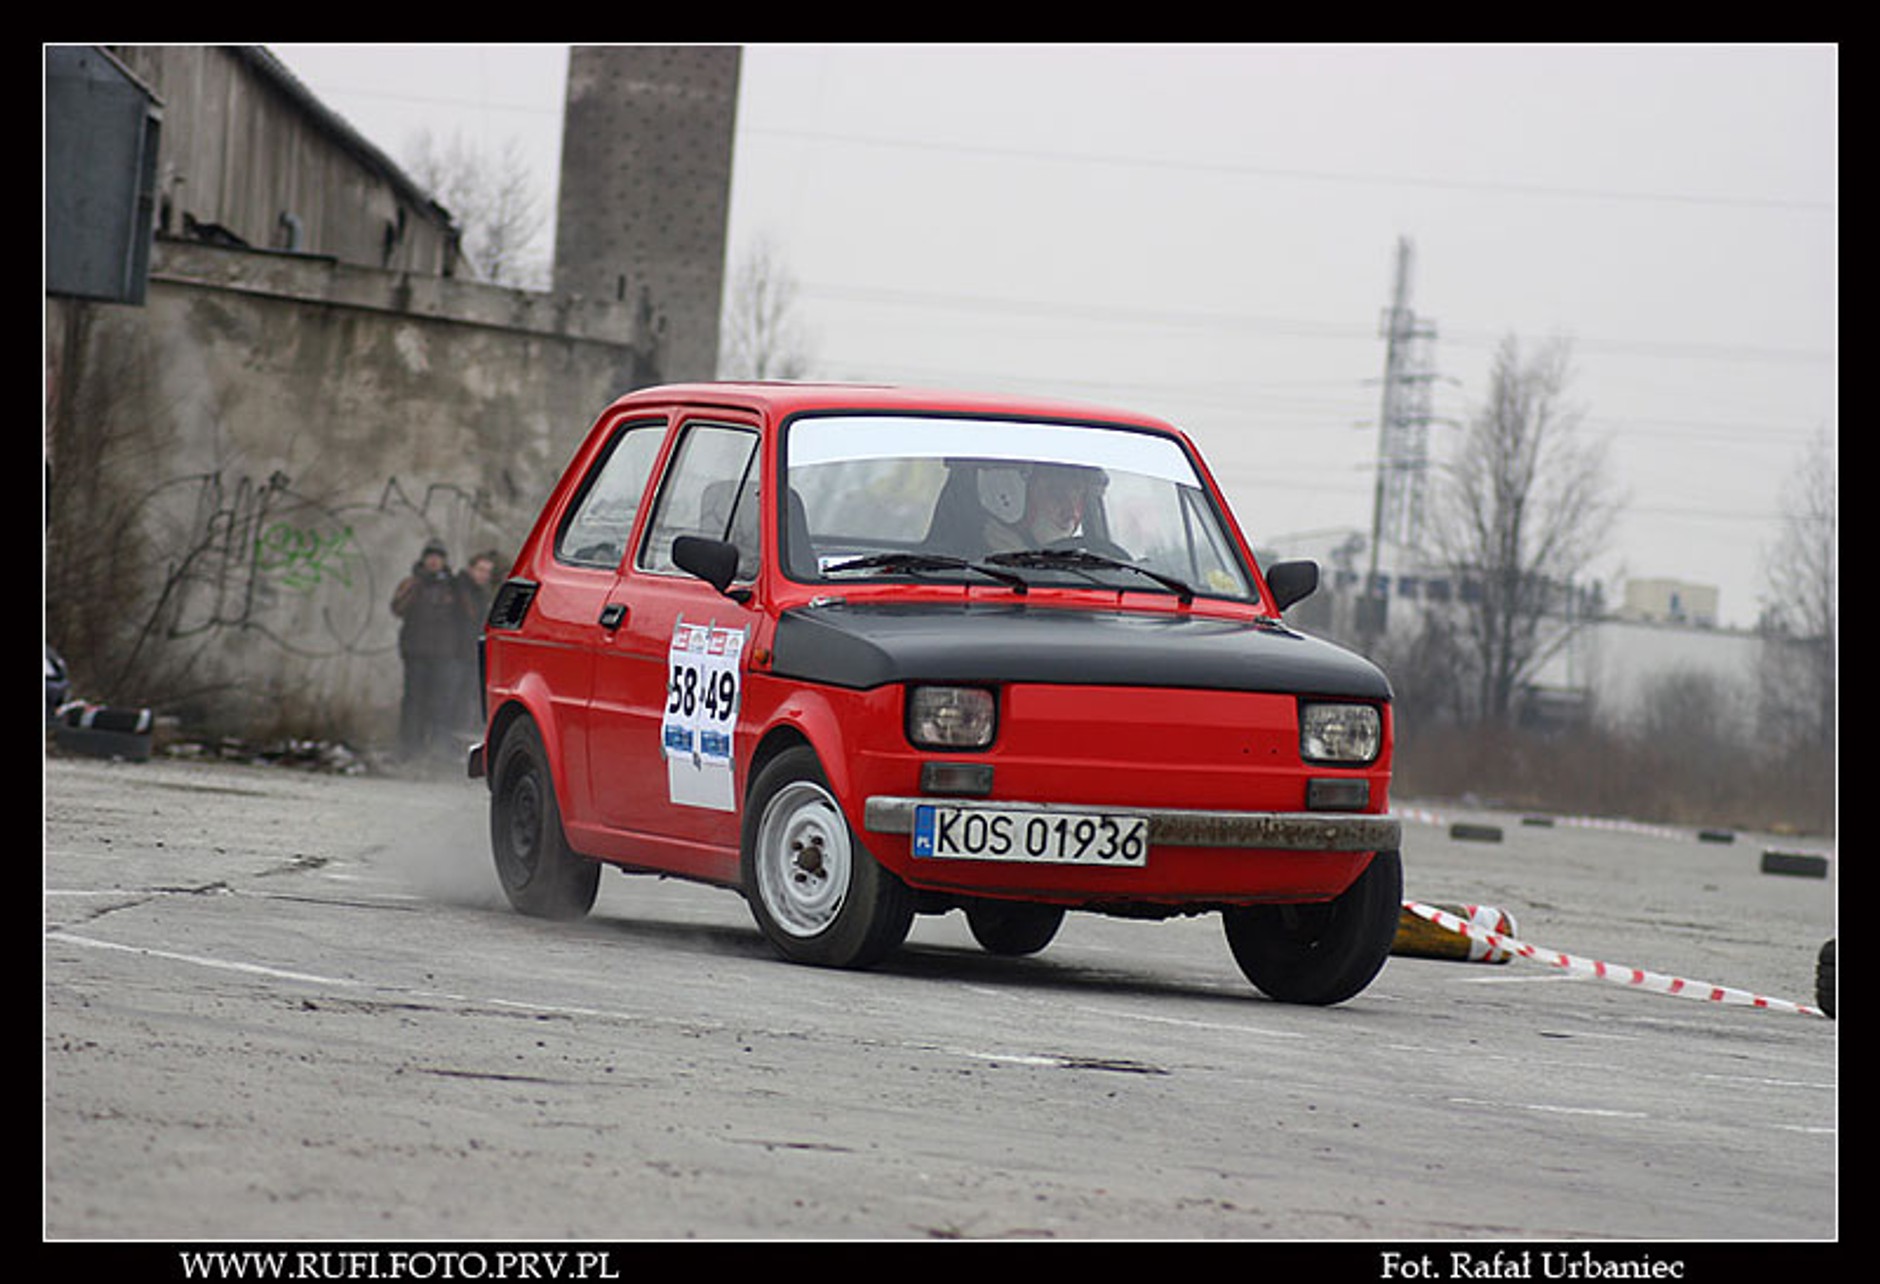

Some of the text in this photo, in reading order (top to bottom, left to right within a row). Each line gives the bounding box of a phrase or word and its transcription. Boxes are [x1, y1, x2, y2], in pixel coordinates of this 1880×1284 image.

[669, 665, 735, 721] 58 49
[937, 811, 1144, 861] KOS 01936
